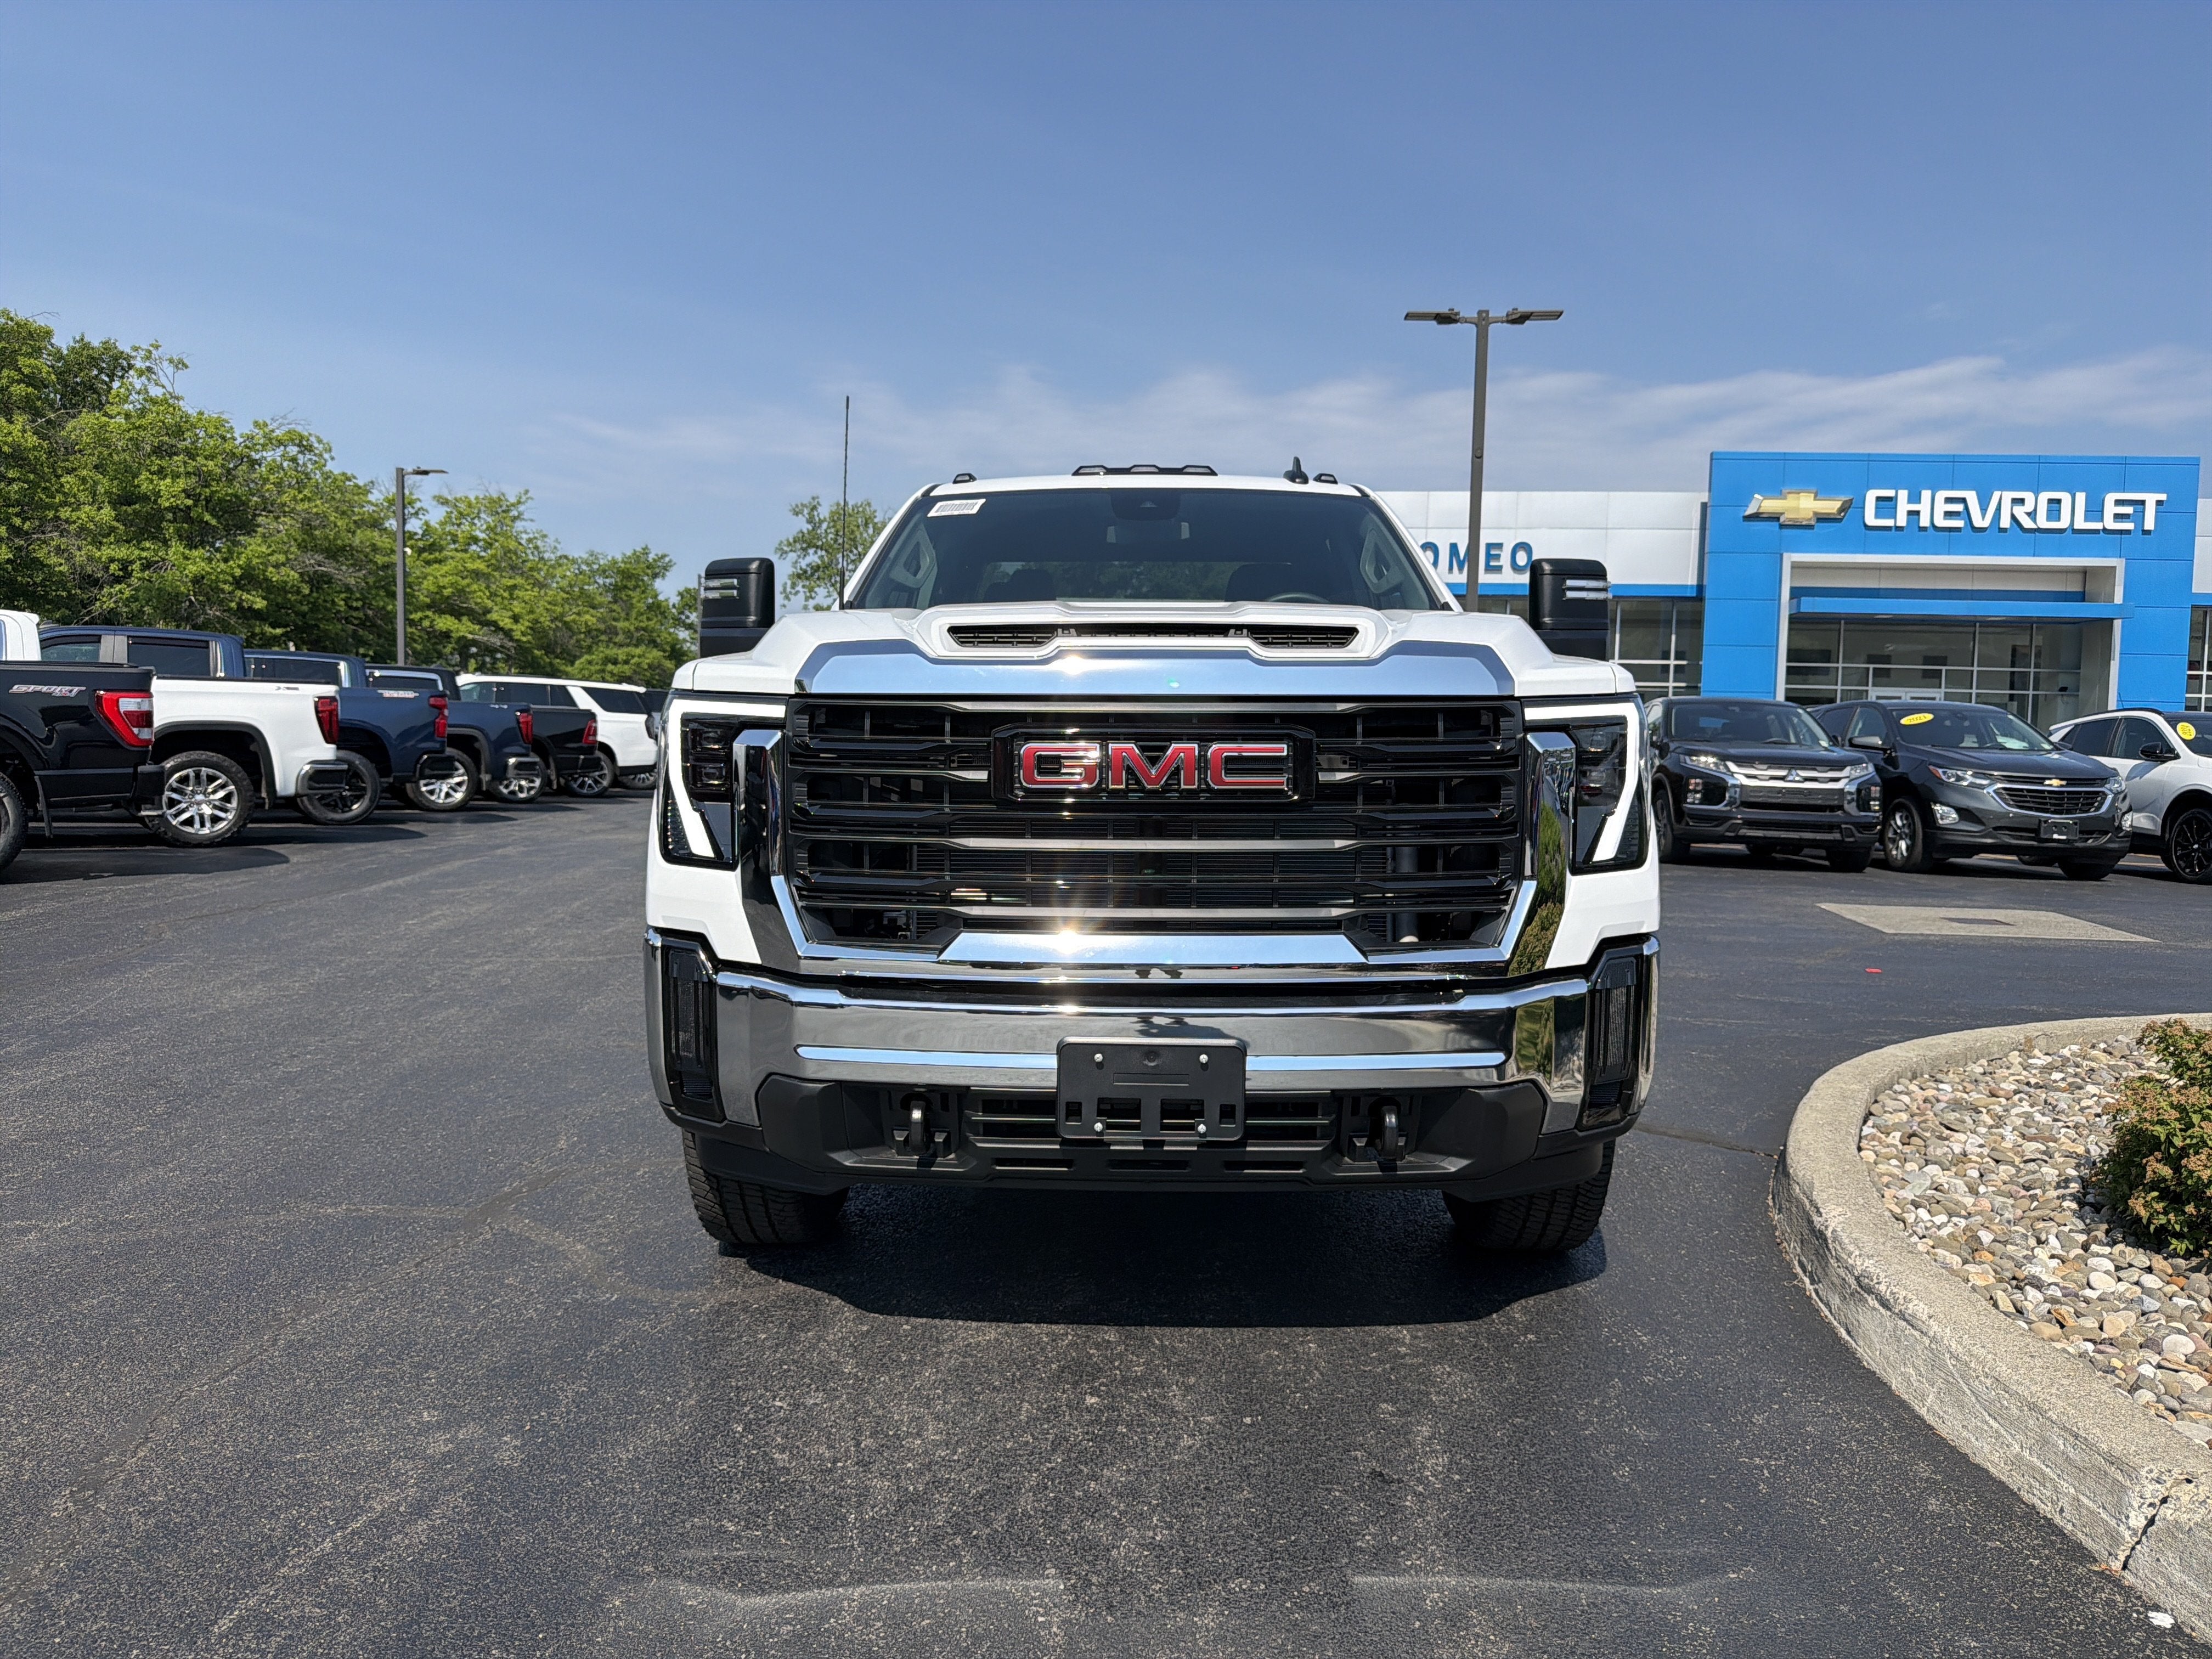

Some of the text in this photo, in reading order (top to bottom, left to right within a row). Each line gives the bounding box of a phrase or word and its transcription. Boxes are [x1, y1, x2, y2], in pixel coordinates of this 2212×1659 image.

[1864, 489, 2168, 532] CHEVROLET
[8, 684, 87, 696] SPORT
[1019, 741, 1288, 789] GMC
